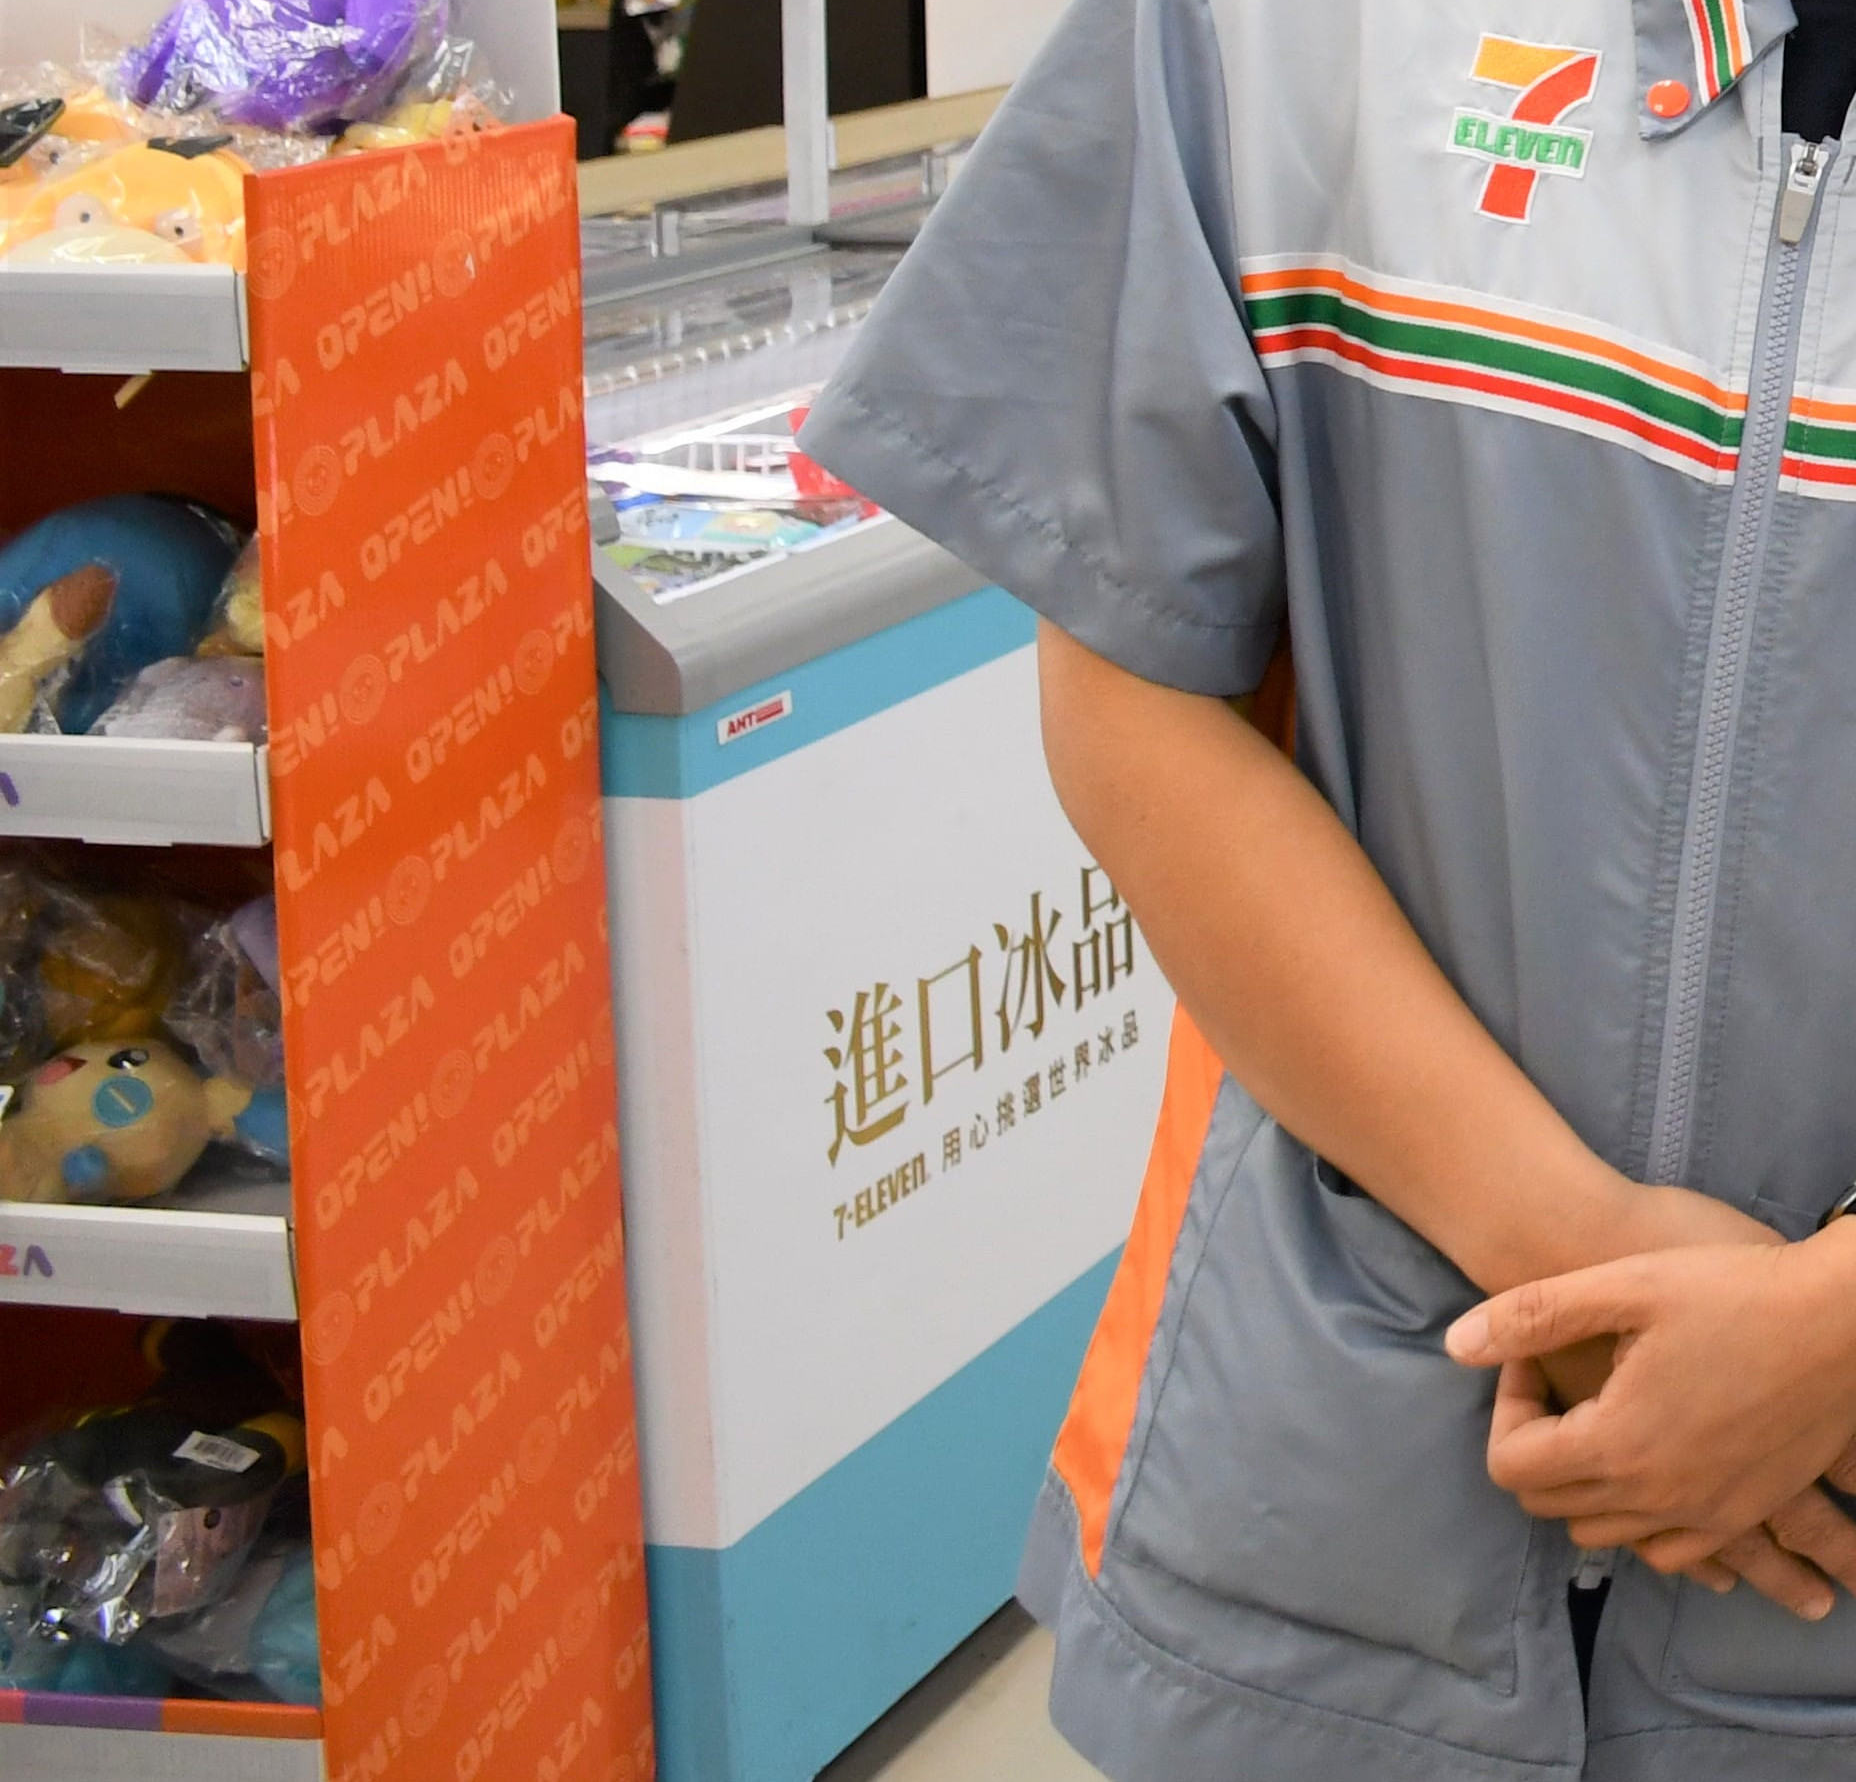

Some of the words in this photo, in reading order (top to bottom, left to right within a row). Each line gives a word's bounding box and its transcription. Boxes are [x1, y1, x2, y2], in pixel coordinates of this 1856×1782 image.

[300, 150, 428, 261] PLAZA
[317, 264, 433, 372] OPEN!
[342, 358, 468, 475] PLAZA
[361, 467, 472, 581] OPEN!
[389, 558, 508, 682] PLAZA
[406, 674, 515, 783] OPEN!
[431, 754, 547, 881] PLAZA
[305, 972, 434, 1120] PLAZA
[472, 941, 587, 1074] PLAZA
[822, 863, 1136, 1169] 進口冰品
[315, 1100, 432, 1231] OPEN!
[352, 1166, 481, 1314] PLAZA
[363, 1292, 480, 1422] OPEN!
[400, 1351, 524, 1503] PLAZA
[410, 1477, 521, 1604] OPEN!
[447, 1528, 565, 1682] PLAZA
